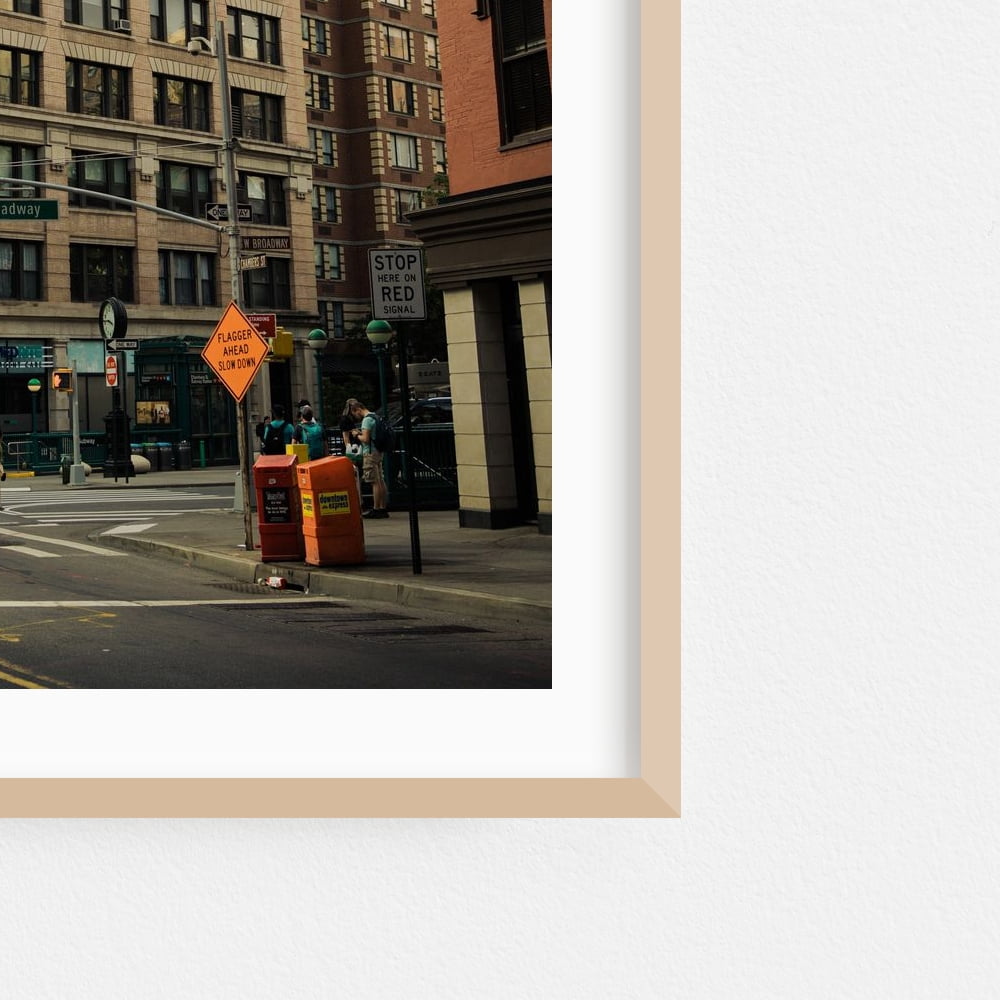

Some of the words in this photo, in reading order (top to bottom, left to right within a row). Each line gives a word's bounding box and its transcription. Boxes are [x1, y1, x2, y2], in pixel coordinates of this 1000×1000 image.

[243, 239, 250, 249] W
[252, 238, 289, 249] BROADWAY
[375, 255, 417, 271] STOP
[377, 274, 400, 283] HERE
[404, 273, 417, 282] ON
[381, 286, 414, 302] RED
[383, 305, 416, 314] SIGNAL
[218, 329, 252, 343] FLAGGER
[223, 344, 249, 356] AHEAD
[218, 360, 236, 371] SLOW
[237, 357, 256, 369] DOWN
[320, 494, 348, 503] downtown
[328, 502, 349, 511] express
